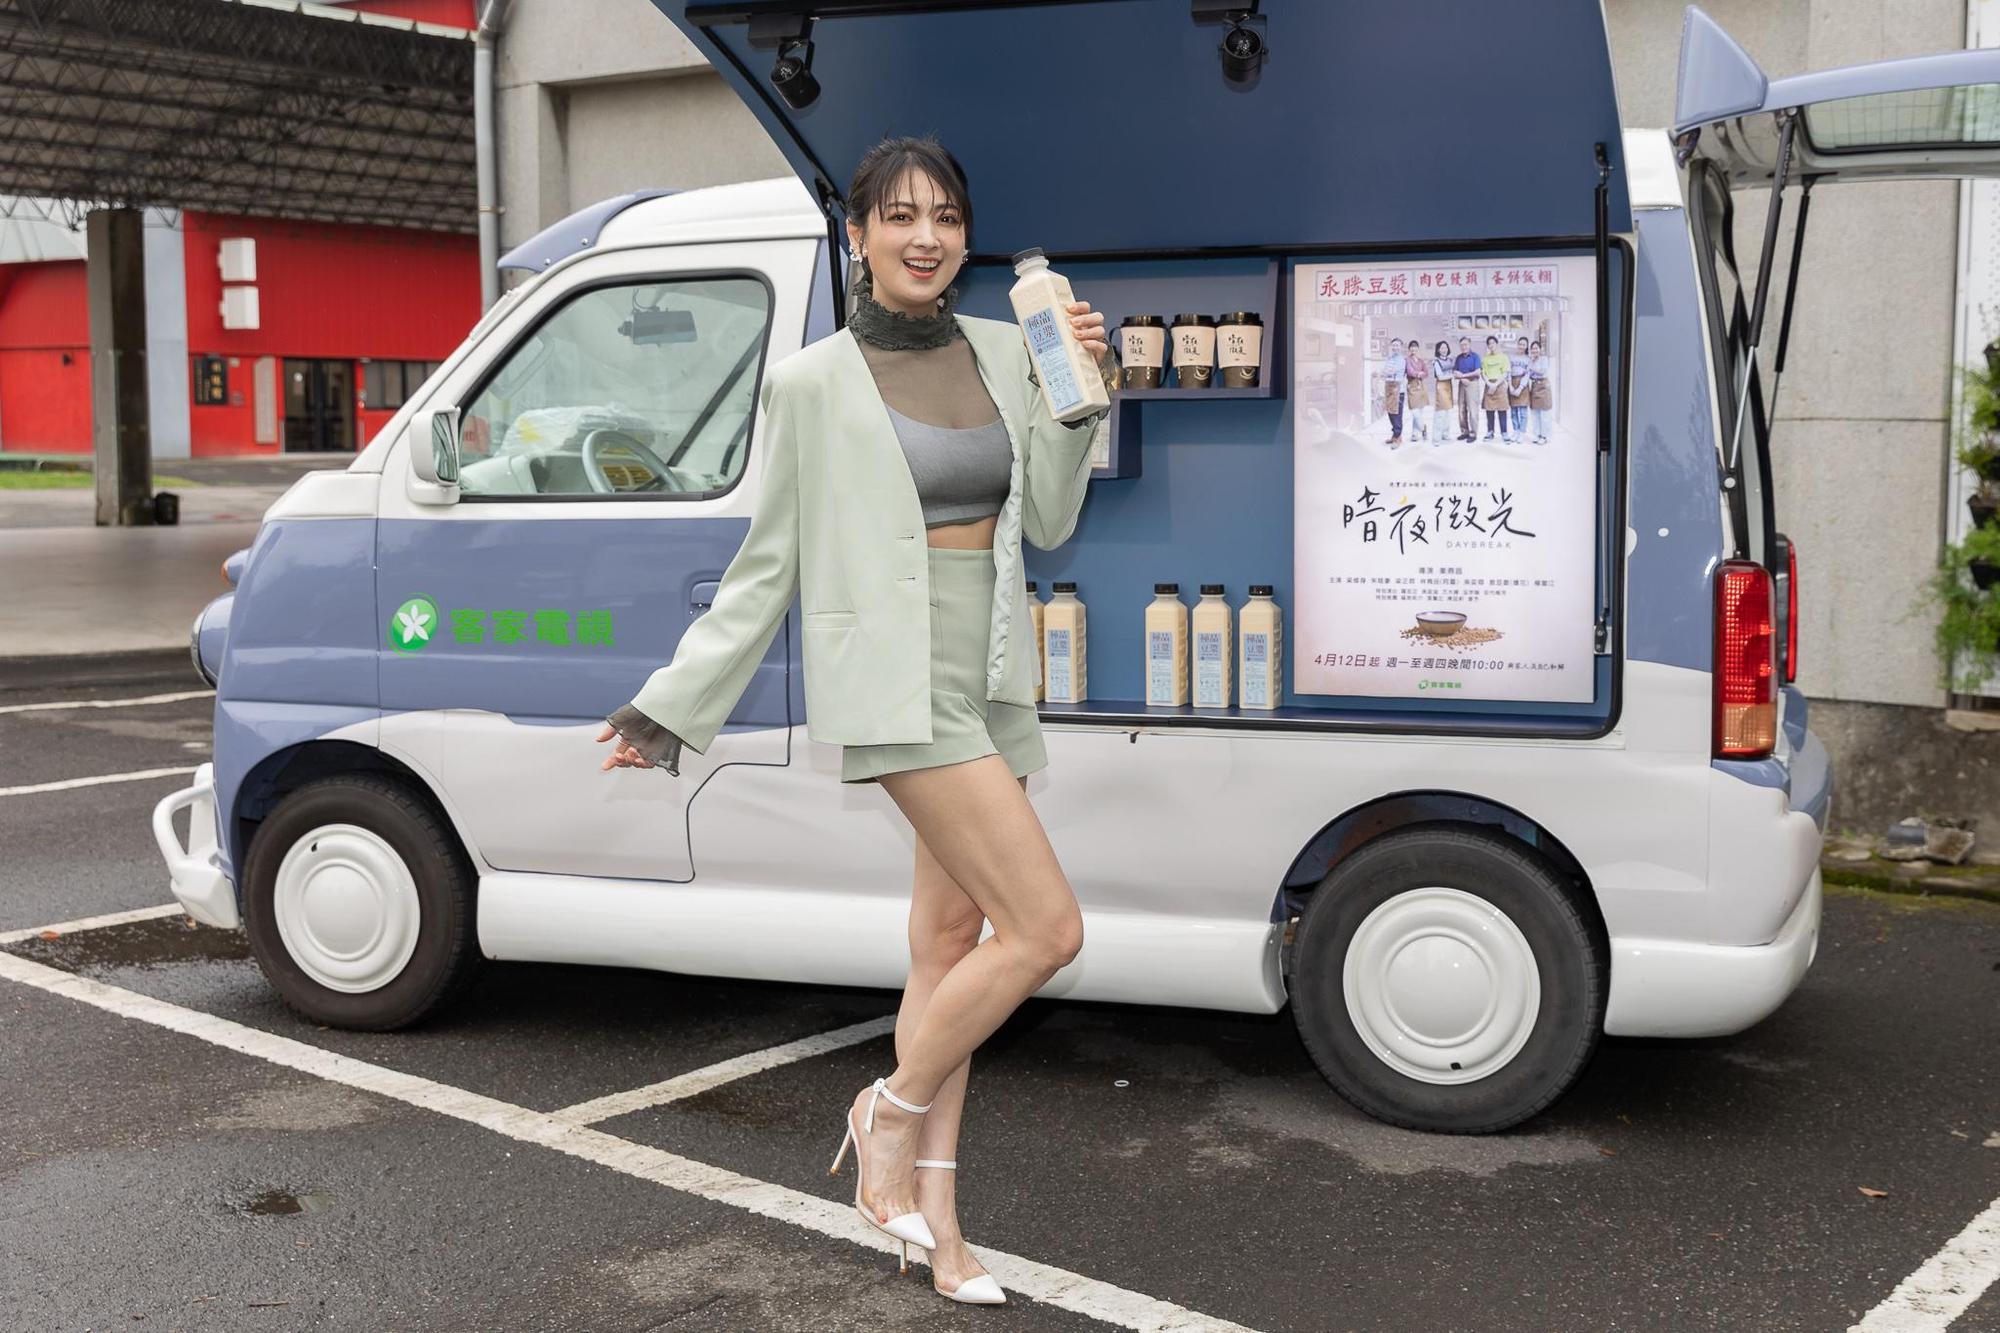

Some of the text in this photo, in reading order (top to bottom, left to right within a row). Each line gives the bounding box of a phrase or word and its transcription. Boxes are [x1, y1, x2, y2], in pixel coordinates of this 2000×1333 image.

[1319, 272, 1409, 297] 永勝豆漿
[1419, 271, 1478, 288] 肉包饅頭
[1027, 312, 1051, 331] 極品
[1033, 324, 1055, 342] 豆漿
[1343, 485, 1536, 555] 暗夜微光
[1446, 541, 1512, 549] DAYBREAK
[450, 609, 615, 647] 客家電視
[1313, 653, 1381, 668] 4月12日起
[1386, 656, 1504, 671] 週一至週四晚間10:00
